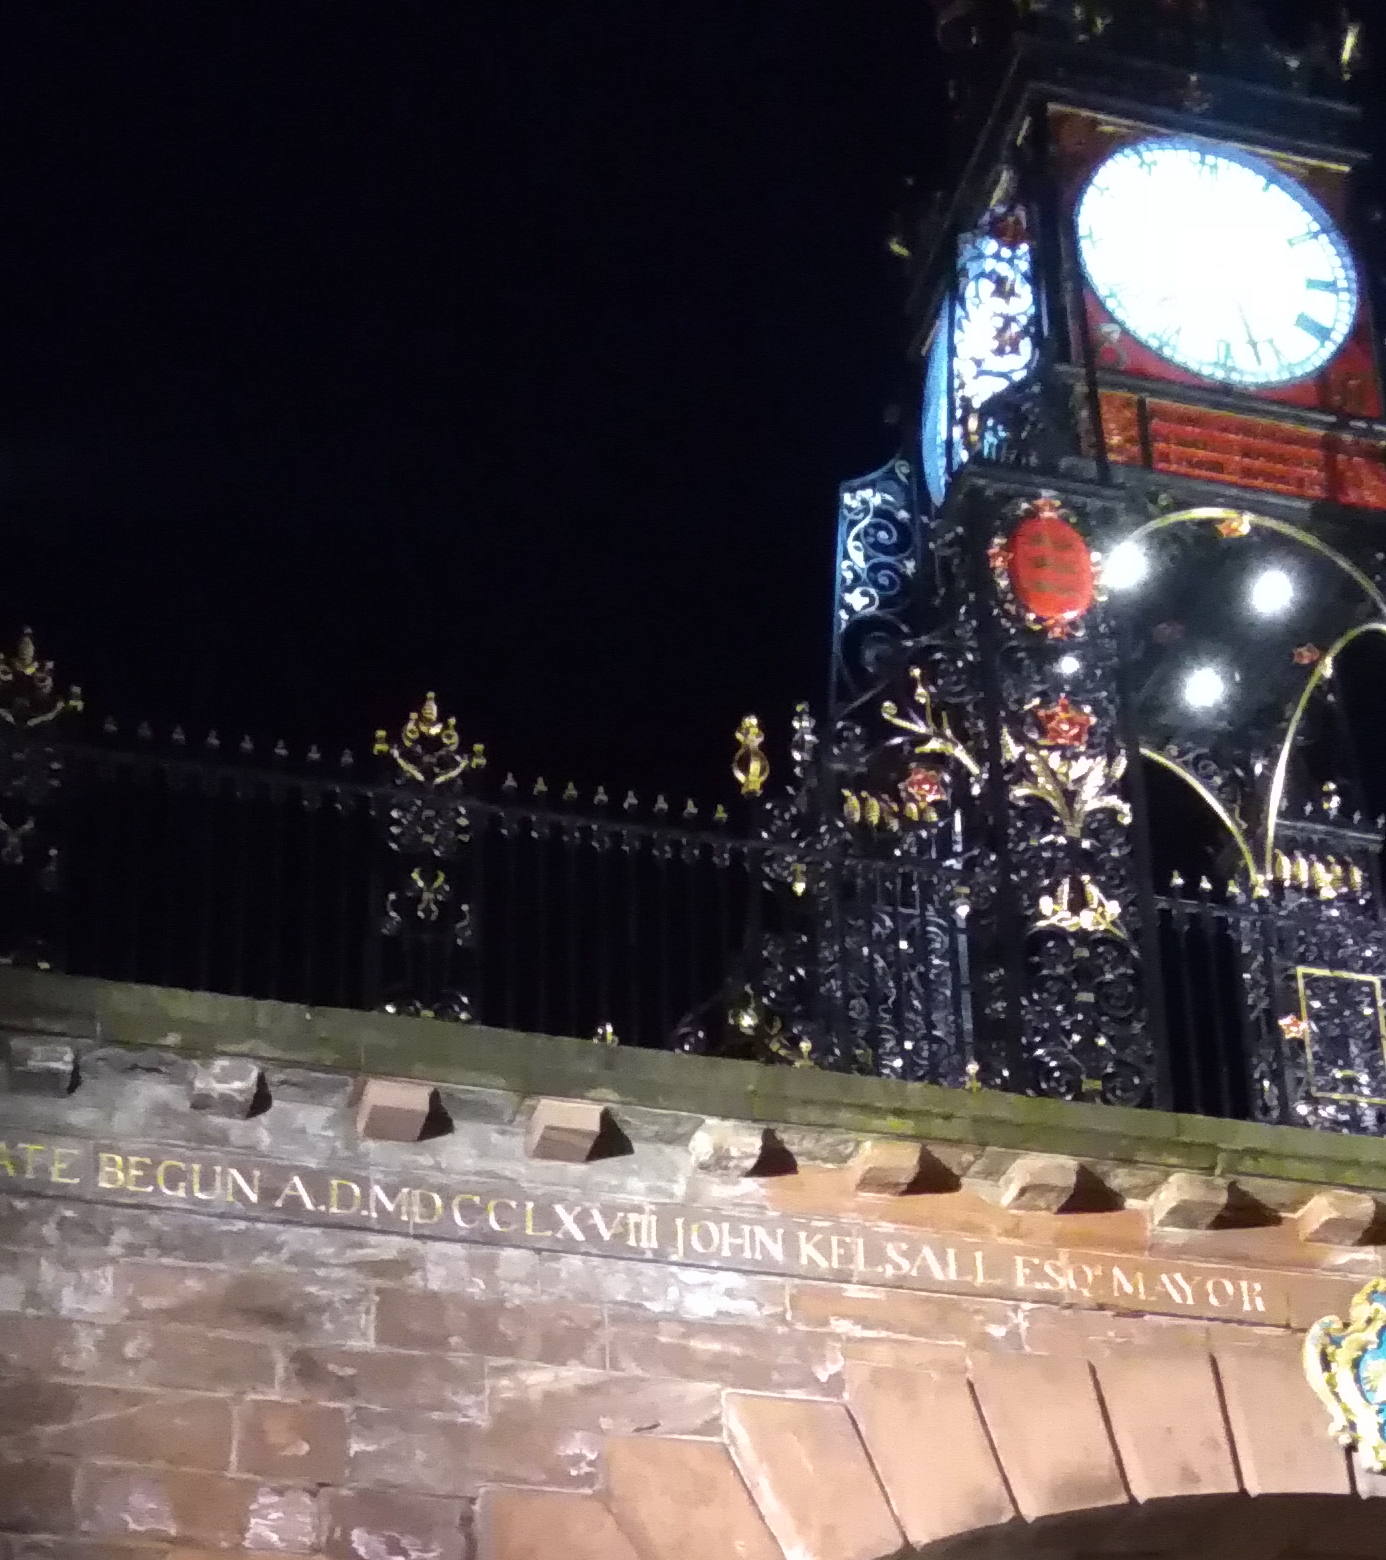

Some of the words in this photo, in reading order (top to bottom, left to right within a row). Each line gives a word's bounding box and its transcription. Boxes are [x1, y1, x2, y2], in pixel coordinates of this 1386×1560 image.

[98, 1152, 261, 1205] BEGUN
[669, 1215, 783, 1262] JOHN
[799, 1233, 997, 1287] KELSALL
[1112, 1266, 1265, 1312] MAYOR
